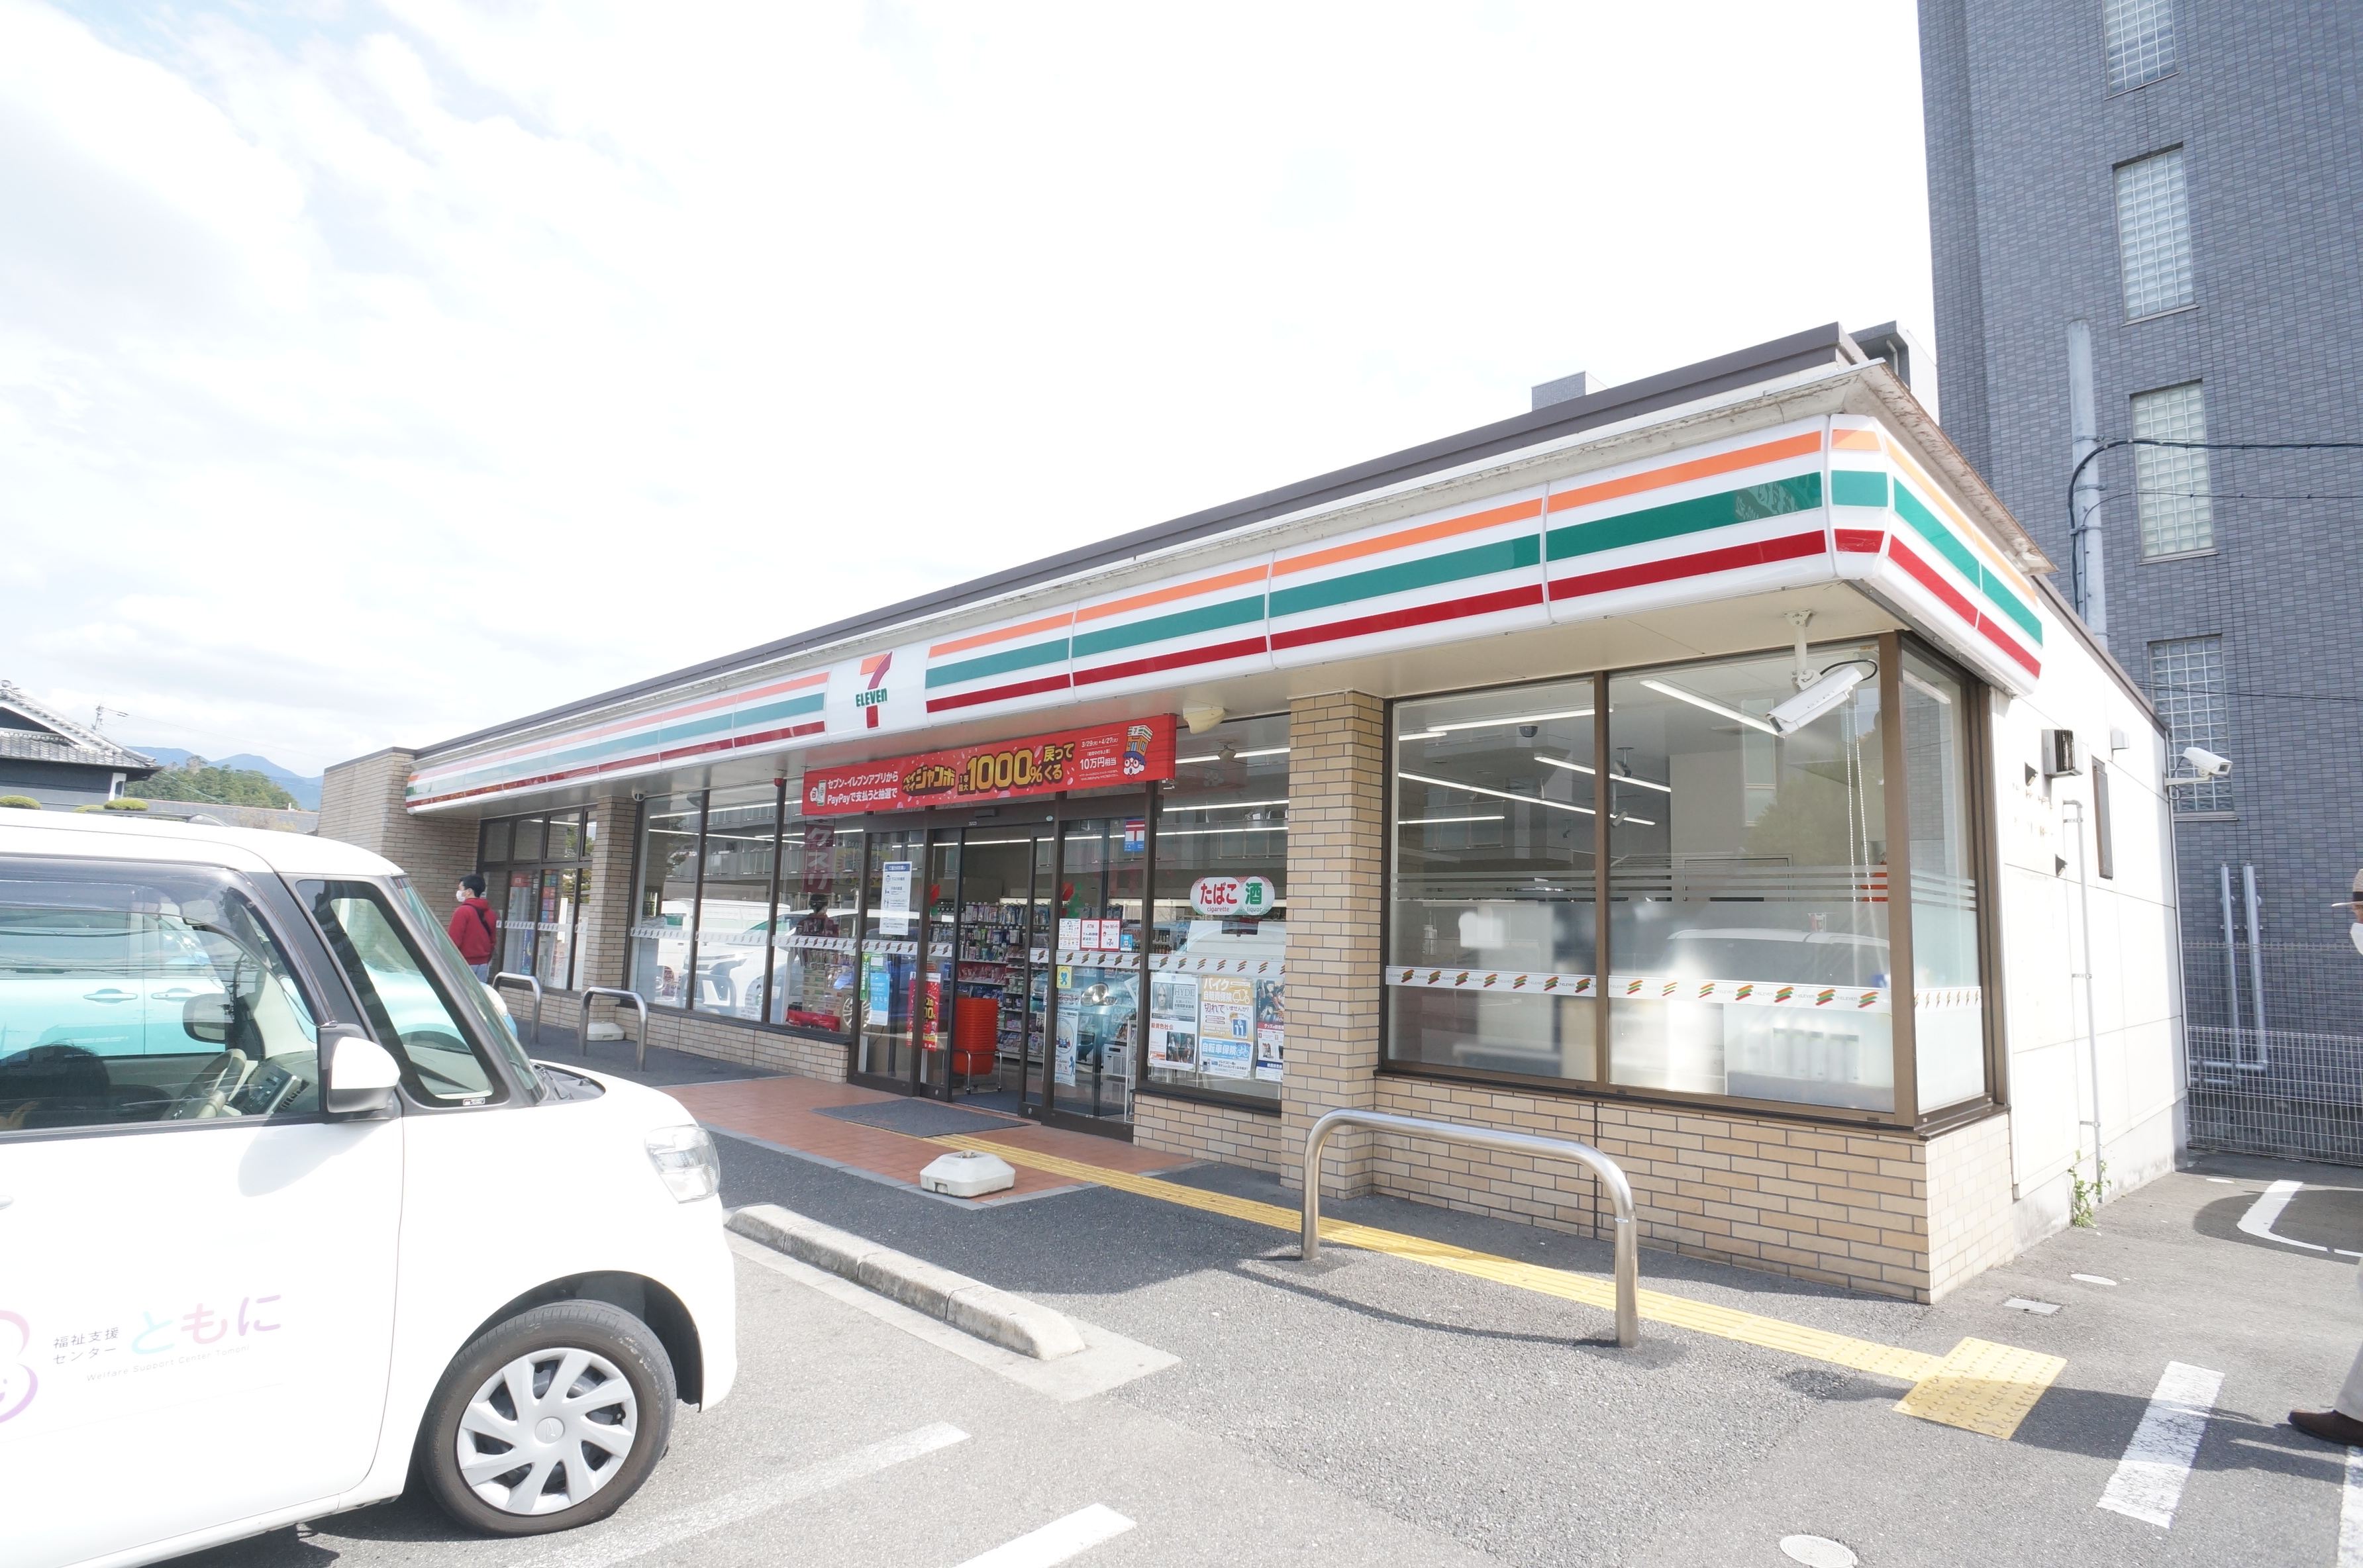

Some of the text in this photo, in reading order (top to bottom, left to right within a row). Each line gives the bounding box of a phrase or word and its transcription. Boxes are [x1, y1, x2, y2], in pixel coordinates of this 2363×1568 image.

[1043, 743, 1074, 762] 戻って
[1044, 764, 1062, 781] くる
[1080, 757, 1117, 770] 10万円相当
[827, 787, 898, 806] PayPayで支払うと抽選で
[1200, 882, 1263, 905] たばこ 酒
[1174, 987, 1195, 997] HYDE
[1203, 977, 1230, 991] バイク
[1202, 1042, 1236, 1055] 自転車保険
[131, 1294, 282, 1355] ともに
[53, 1326, 120, 1349] 福祉支援
[52, 1347, 117, 1365] センター
[87, 1344, 250, 1382] Welfare Support Center Tomoni
